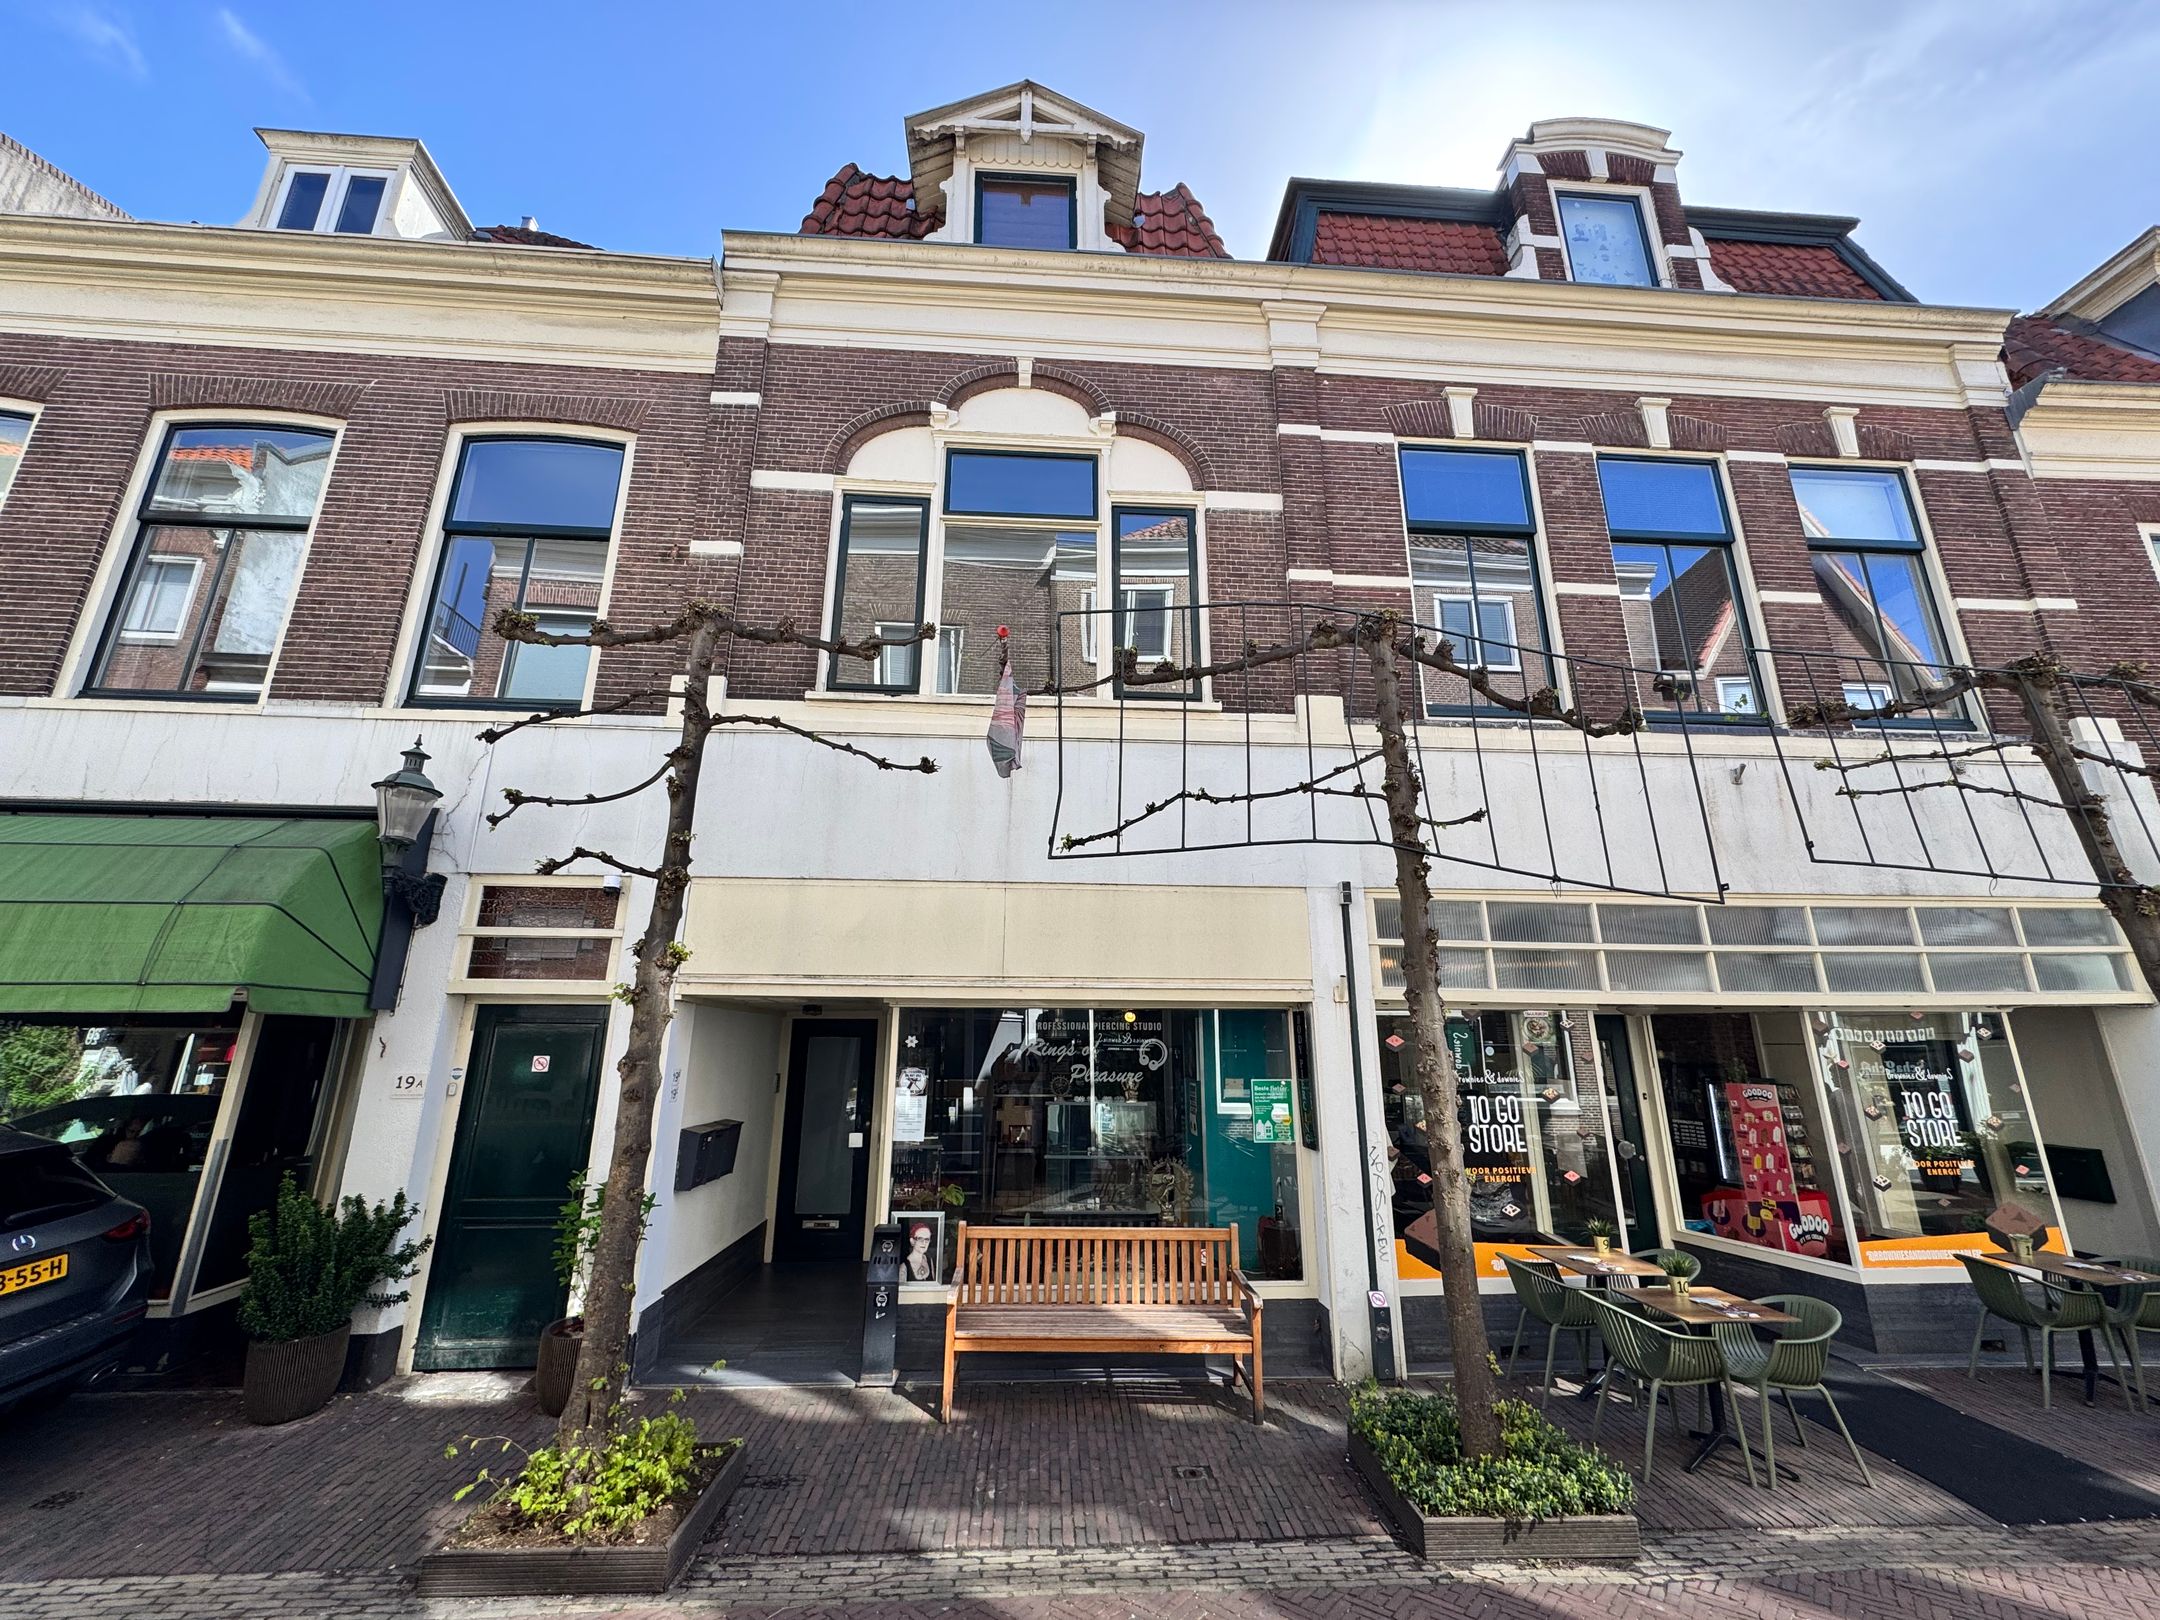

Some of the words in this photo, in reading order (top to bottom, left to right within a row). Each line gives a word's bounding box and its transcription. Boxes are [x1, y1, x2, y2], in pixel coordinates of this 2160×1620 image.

[1034, 1021, 1089, 1030] ROFESSIONAL
[1094, 1021, 1131, 1031] PIERCING
[1133, 1021, 1162, 1031] STUDIO
[1025, 1038, 1077, 1063] Rings
[1070, 1063, 1144, 1084] Pleasure
[1742, 1087, 1774, 1099] GOODOO
[1466, 1095, 1491, 1124] TO
[1494, 1095, 1520, 1124] GO
[1900, 1091, 1926, 1119] TO
[1928, 1091, 1953, 1119] GO
[1468, 1124, 1528, 1153] STORE
[1906, 1119, 1966, 1147] STORE
[1484, 1175, 1521, 1183] ENERGIE
[1926, 1168, 1962, 1176] ENERGIE
[1602, 1239, 1609, 1250] 9
[1677, 1280, 1690, 1294] 10
